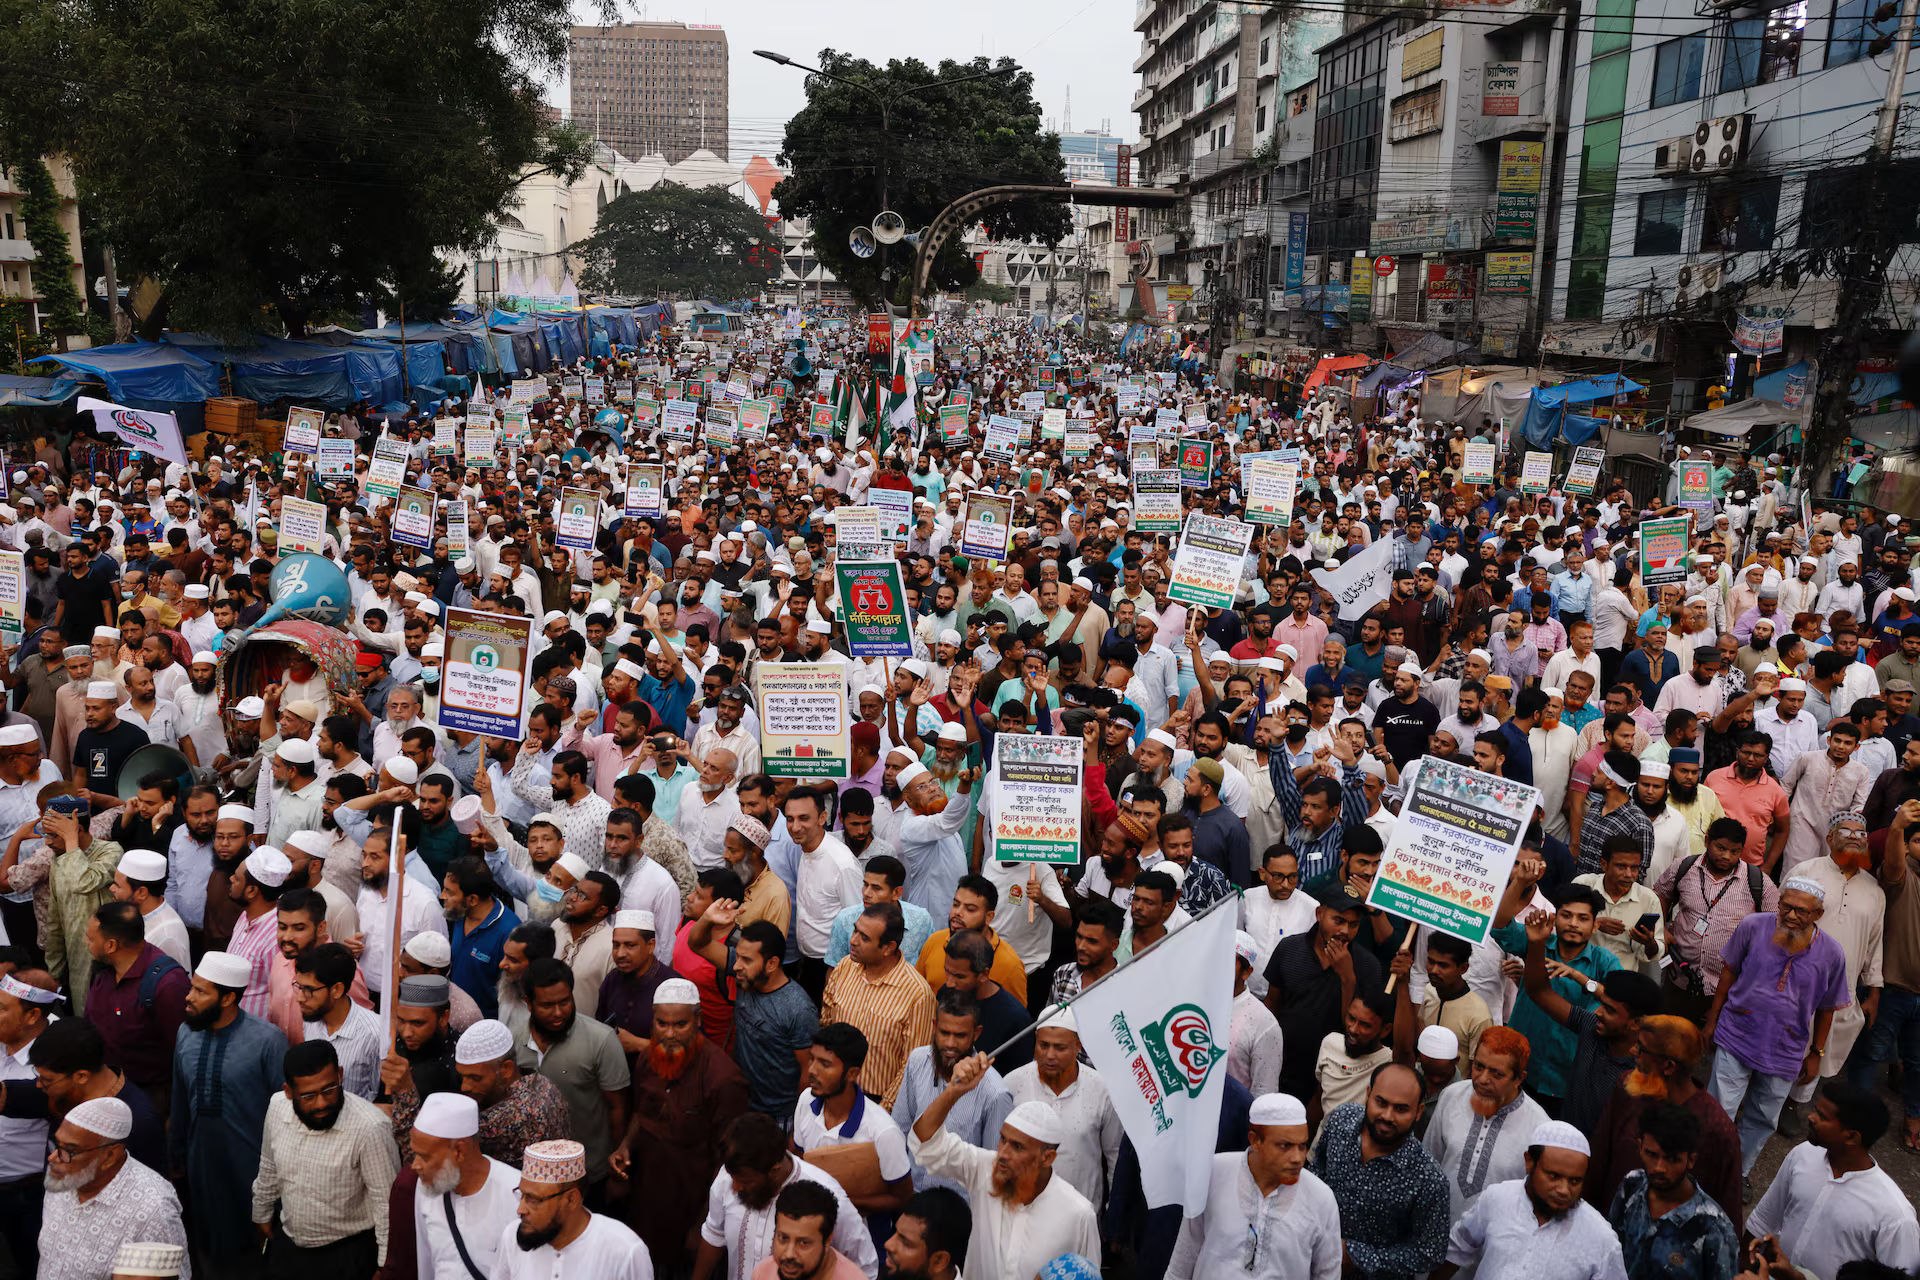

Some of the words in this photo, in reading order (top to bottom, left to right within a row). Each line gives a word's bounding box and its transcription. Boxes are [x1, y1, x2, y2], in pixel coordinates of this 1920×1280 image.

[1488, 80, 1516, 90] ফোম
[848, 610, 903, 626] দাঁড়িপাল্লার
[93, 752, 105, 772] 2
[1415, 791, 1449, 809] বাংলাদেশ
[1483, 812, 1518, 831] ইসলামীর
[1407, 813, 1441, 832] ফ্যাসিস্ট
[1441, 826, 1481, 846] সরকারের
[1482, 840, 1506, 854] সকল
[1467, 818, 1478, 829] ৫
[1477, 823, 1492, 834] দফা
[1491, 826, 1508, 840] দাবি
[1408, 842, 1442, 860] গণহত্যা
[1443, 854, 1452, 863] ও
[1392, 847, 1420, 866] বিচার
[1418, 859, 1451, 880] দৃশ্যমান
[1452, 871, 1478, 887] করতে
[1478, 880, 1496, 893] হবে
[1379, 884, 1416, 903] বাংলাদেশ
[1451, 908, 1483, 928] ইসলামী
[1393, 899, 1410, 911] ঢাকা
[1110, 1010, 1138, 1058] বাংলাদেশ
[1132, 1053, 1160, 1104] জামায়াতে
